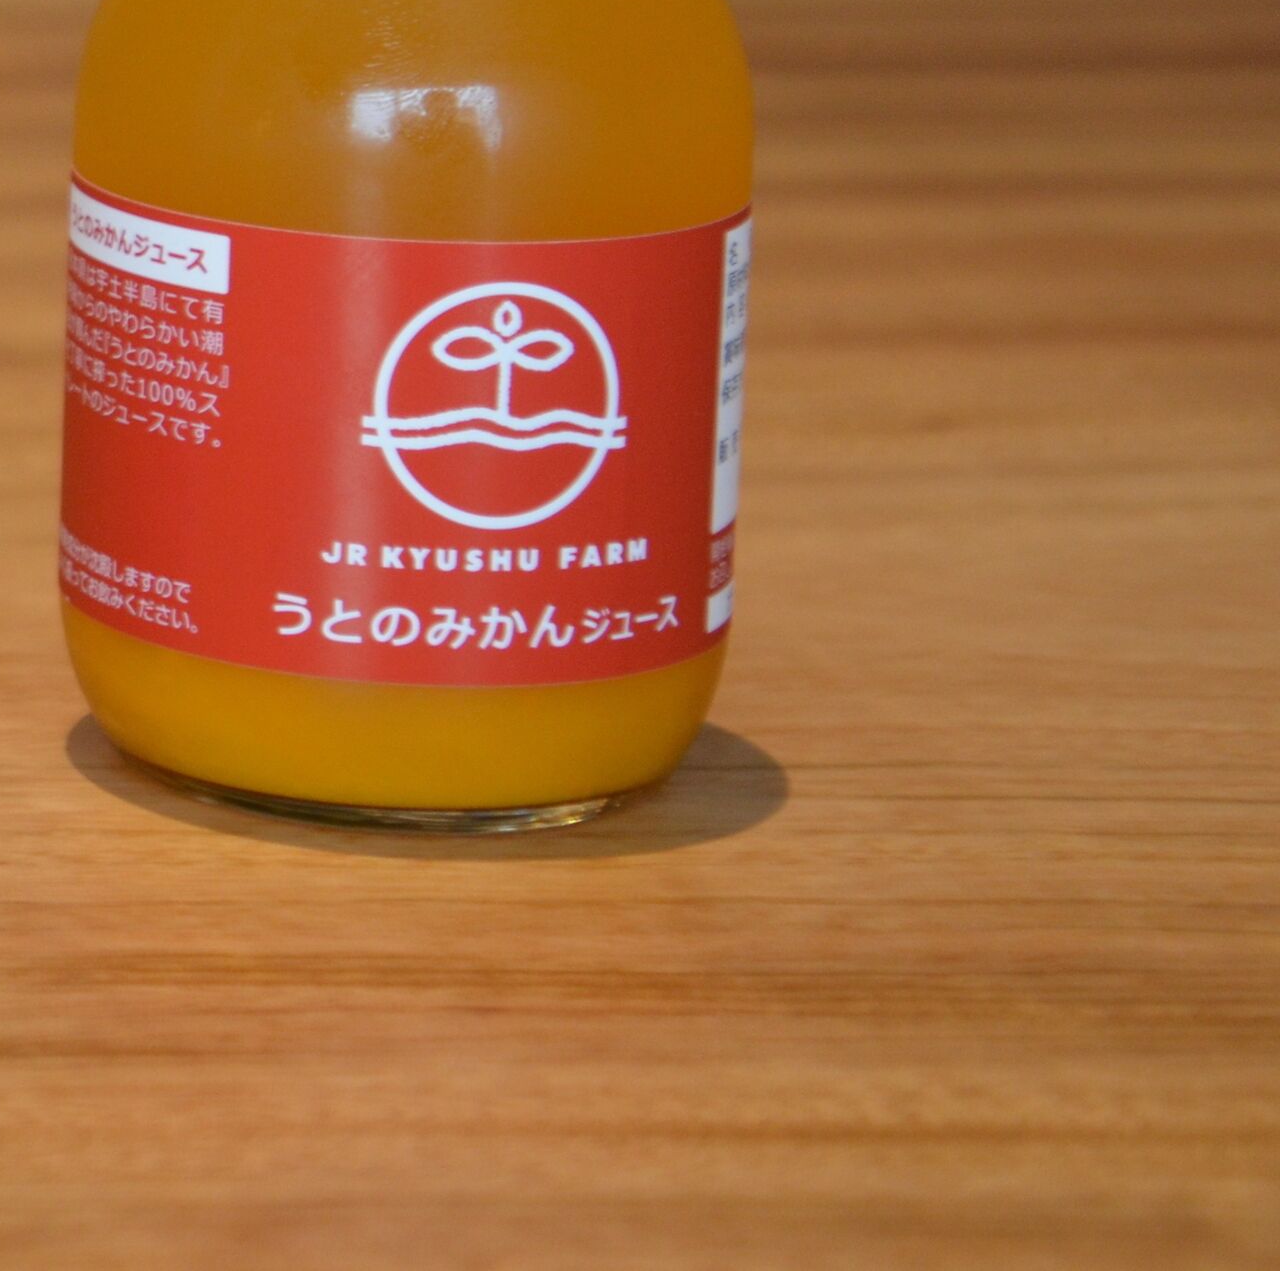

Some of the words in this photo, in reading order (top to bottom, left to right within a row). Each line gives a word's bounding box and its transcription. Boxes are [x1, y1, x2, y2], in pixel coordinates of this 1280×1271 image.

[321, 540, 367, 568] JR
[381, 544, 539, 572] KYUSHU
[560, 538, 649, 570] FARM
[272, 592, 679, 651] うとのみかんジュース
